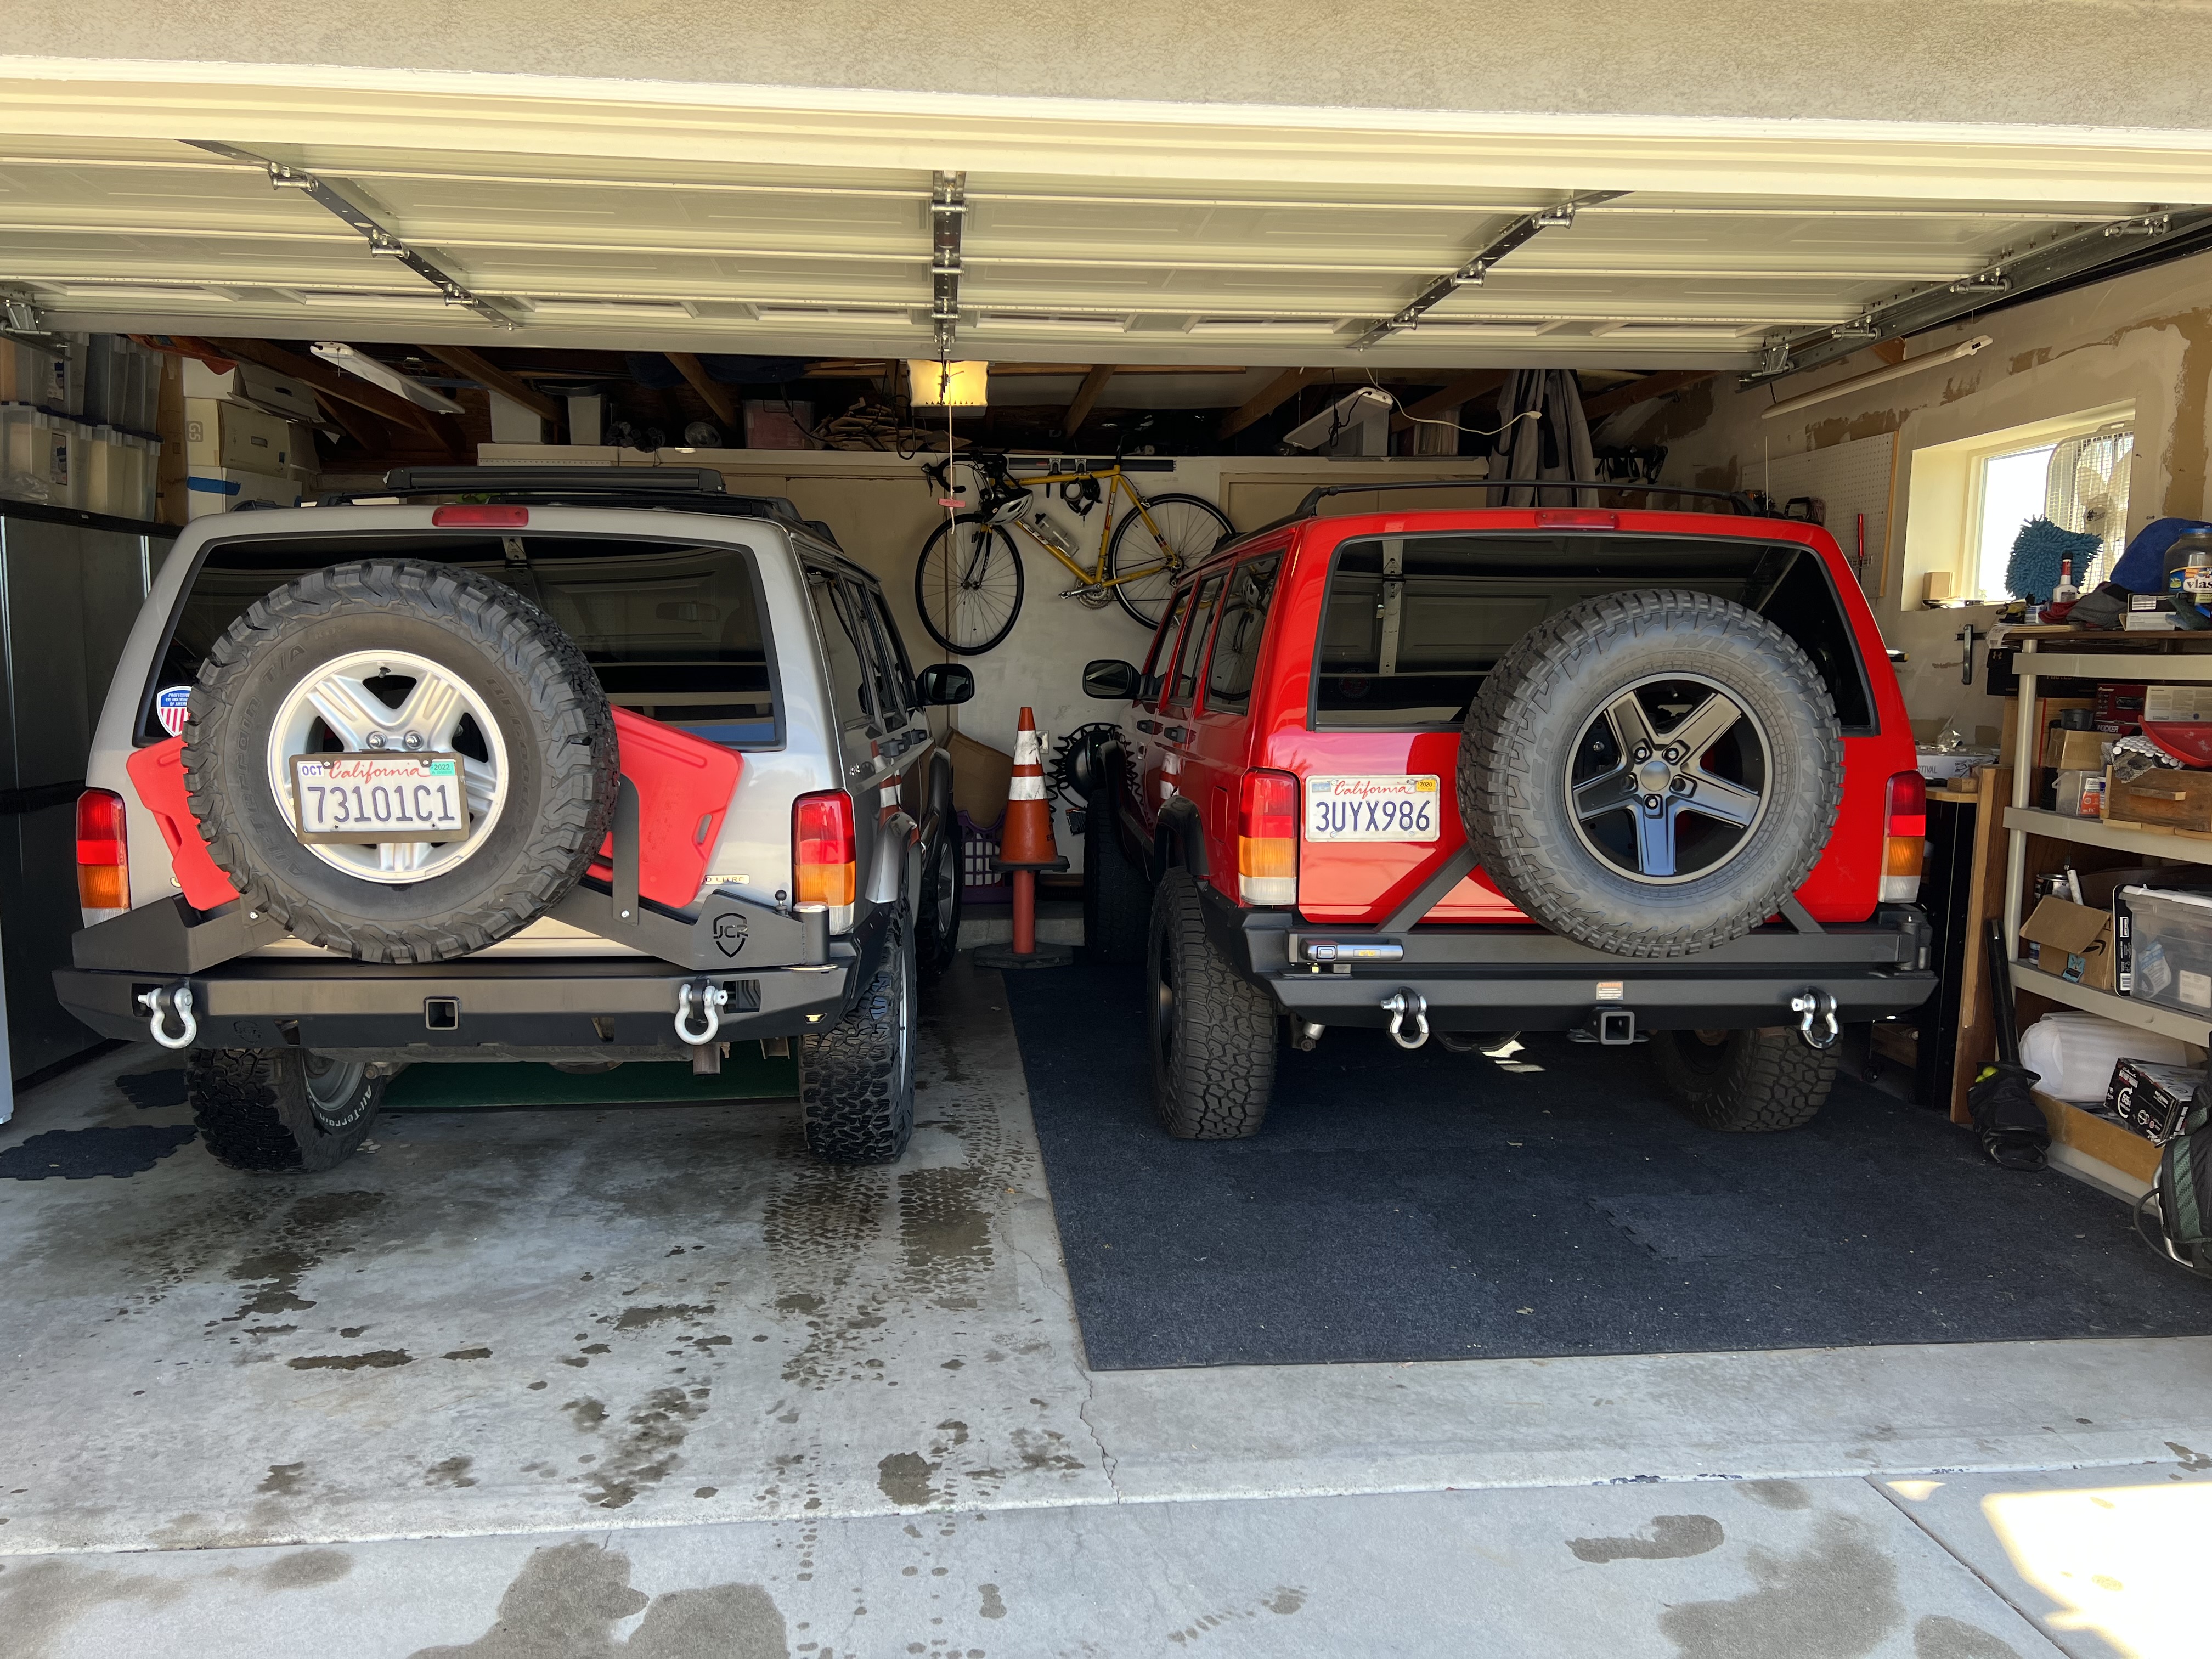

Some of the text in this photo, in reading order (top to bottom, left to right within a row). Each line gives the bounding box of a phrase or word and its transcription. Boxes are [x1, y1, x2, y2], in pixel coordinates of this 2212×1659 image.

[188, 422, 201, 441] G5
[302, 765, 323, 776] OCT
[329, 760, 431, 784] California
[1334, 781, 1415, 799] California
[307, 785, 455, 823] 73101C1
[1316, 800, 1431, 832] 3UYX986
